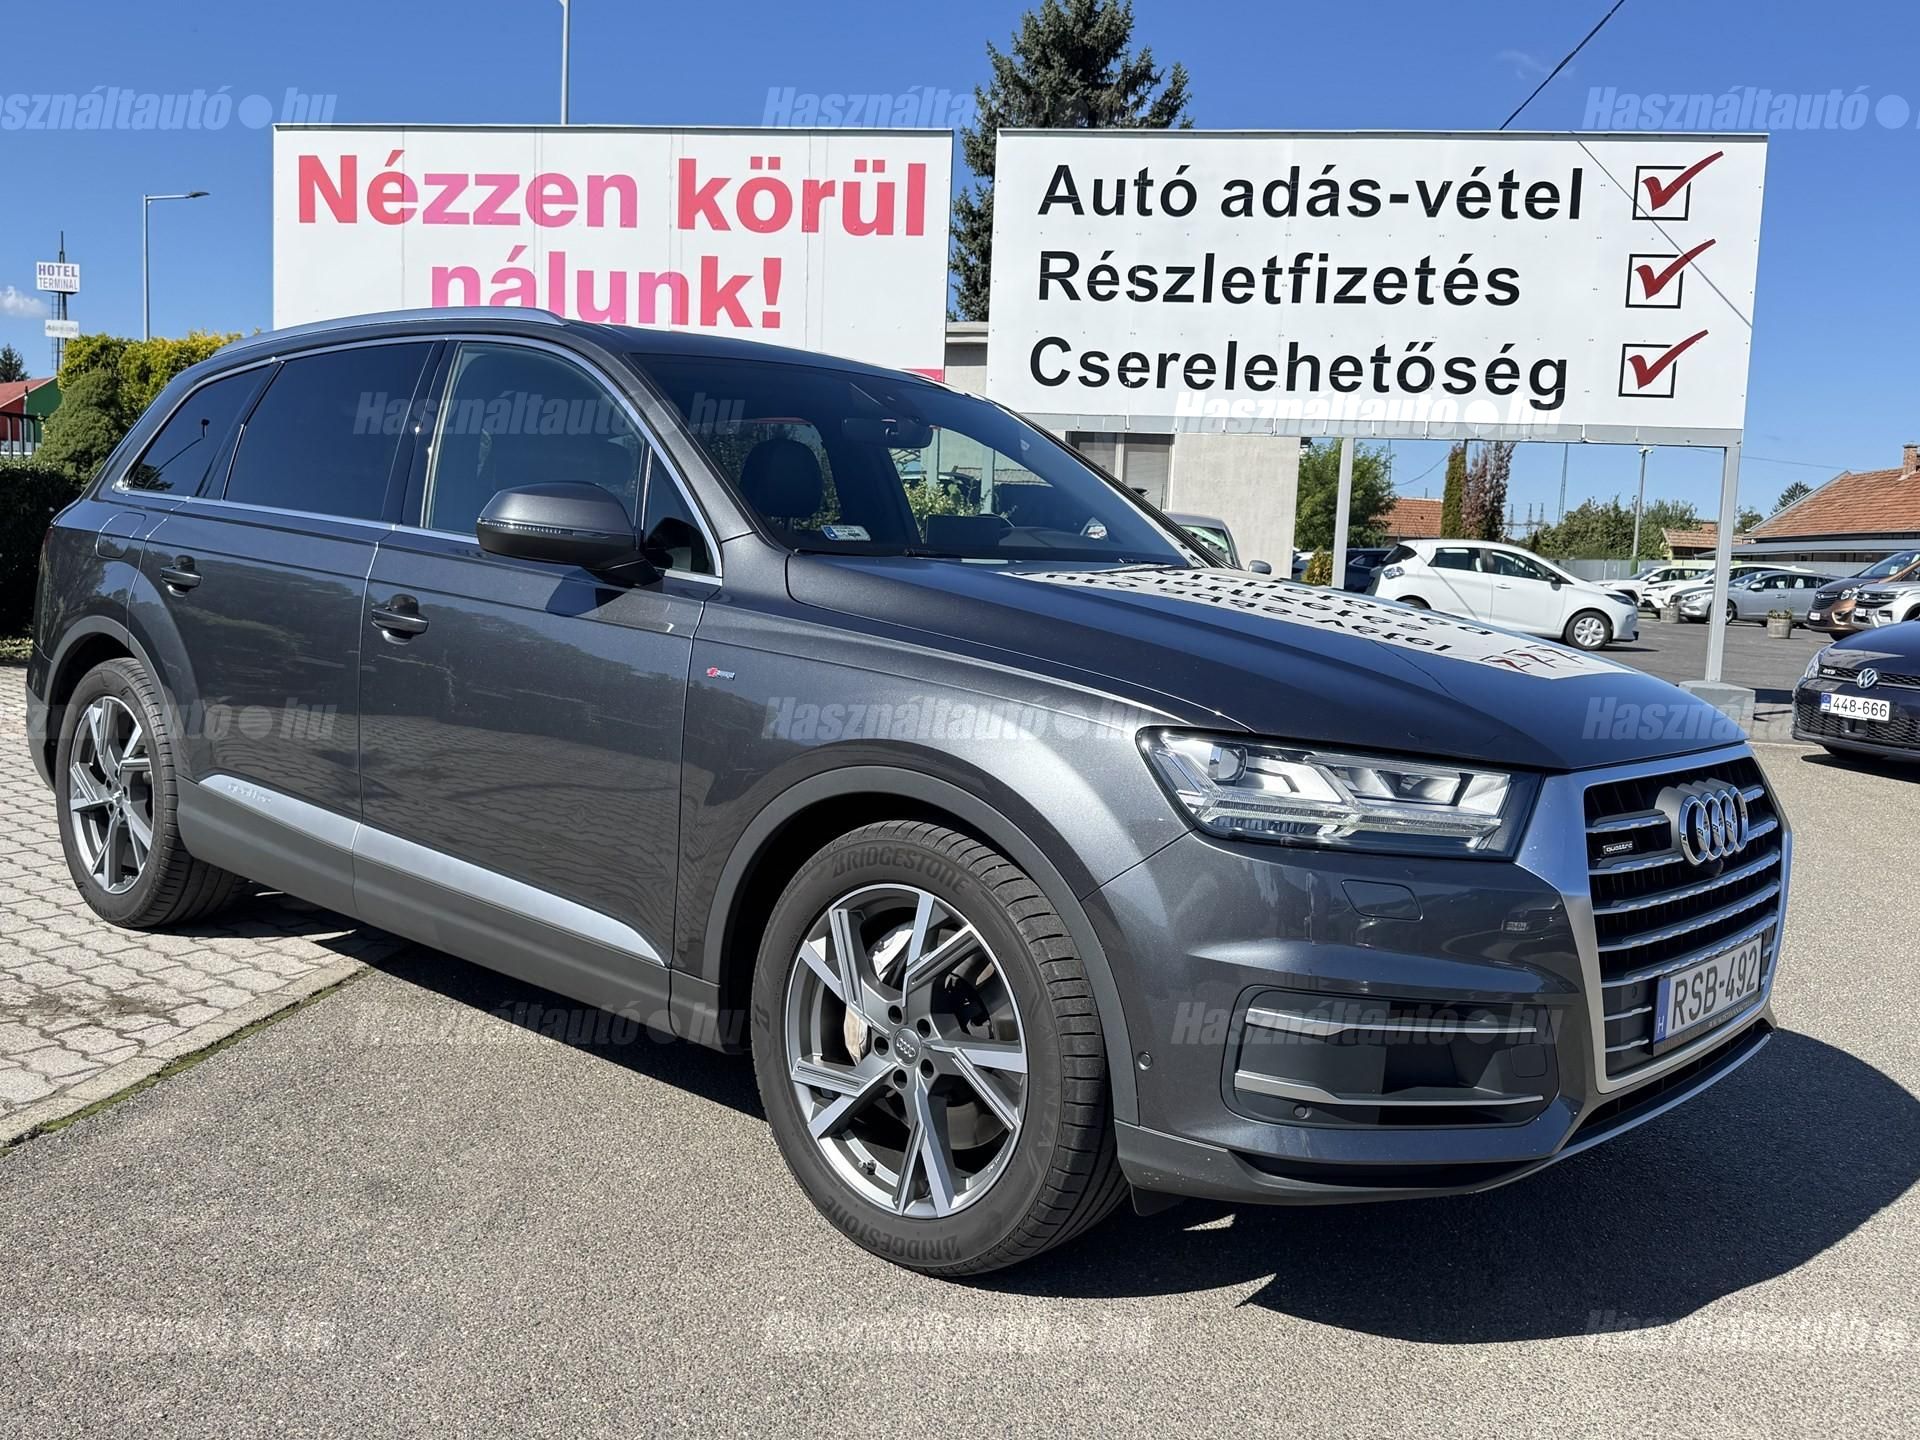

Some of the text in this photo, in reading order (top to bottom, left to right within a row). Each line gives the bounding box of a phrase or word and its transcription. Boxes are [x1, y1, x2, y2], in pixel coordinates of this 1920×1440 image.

[298, 149, 927, 237] Nézzen körül
[1037, 164, 1583, 220] Autó adás-vétel
[38, 264, 78, 277] HOTEL
[38, 277, 78, 290] TERMINAL
[431, 244, 782, 329] nálunk!
[1039, 250, 1521, 306] Részletfizetés
[1030, 336, 1568, 411] Cserelehetőség
[1833, 697, 1887, 718] 448-666
[831, 846, 971, 895] BRIDGESTONE
[1671, 944, 1758, 1031] RSB-492
